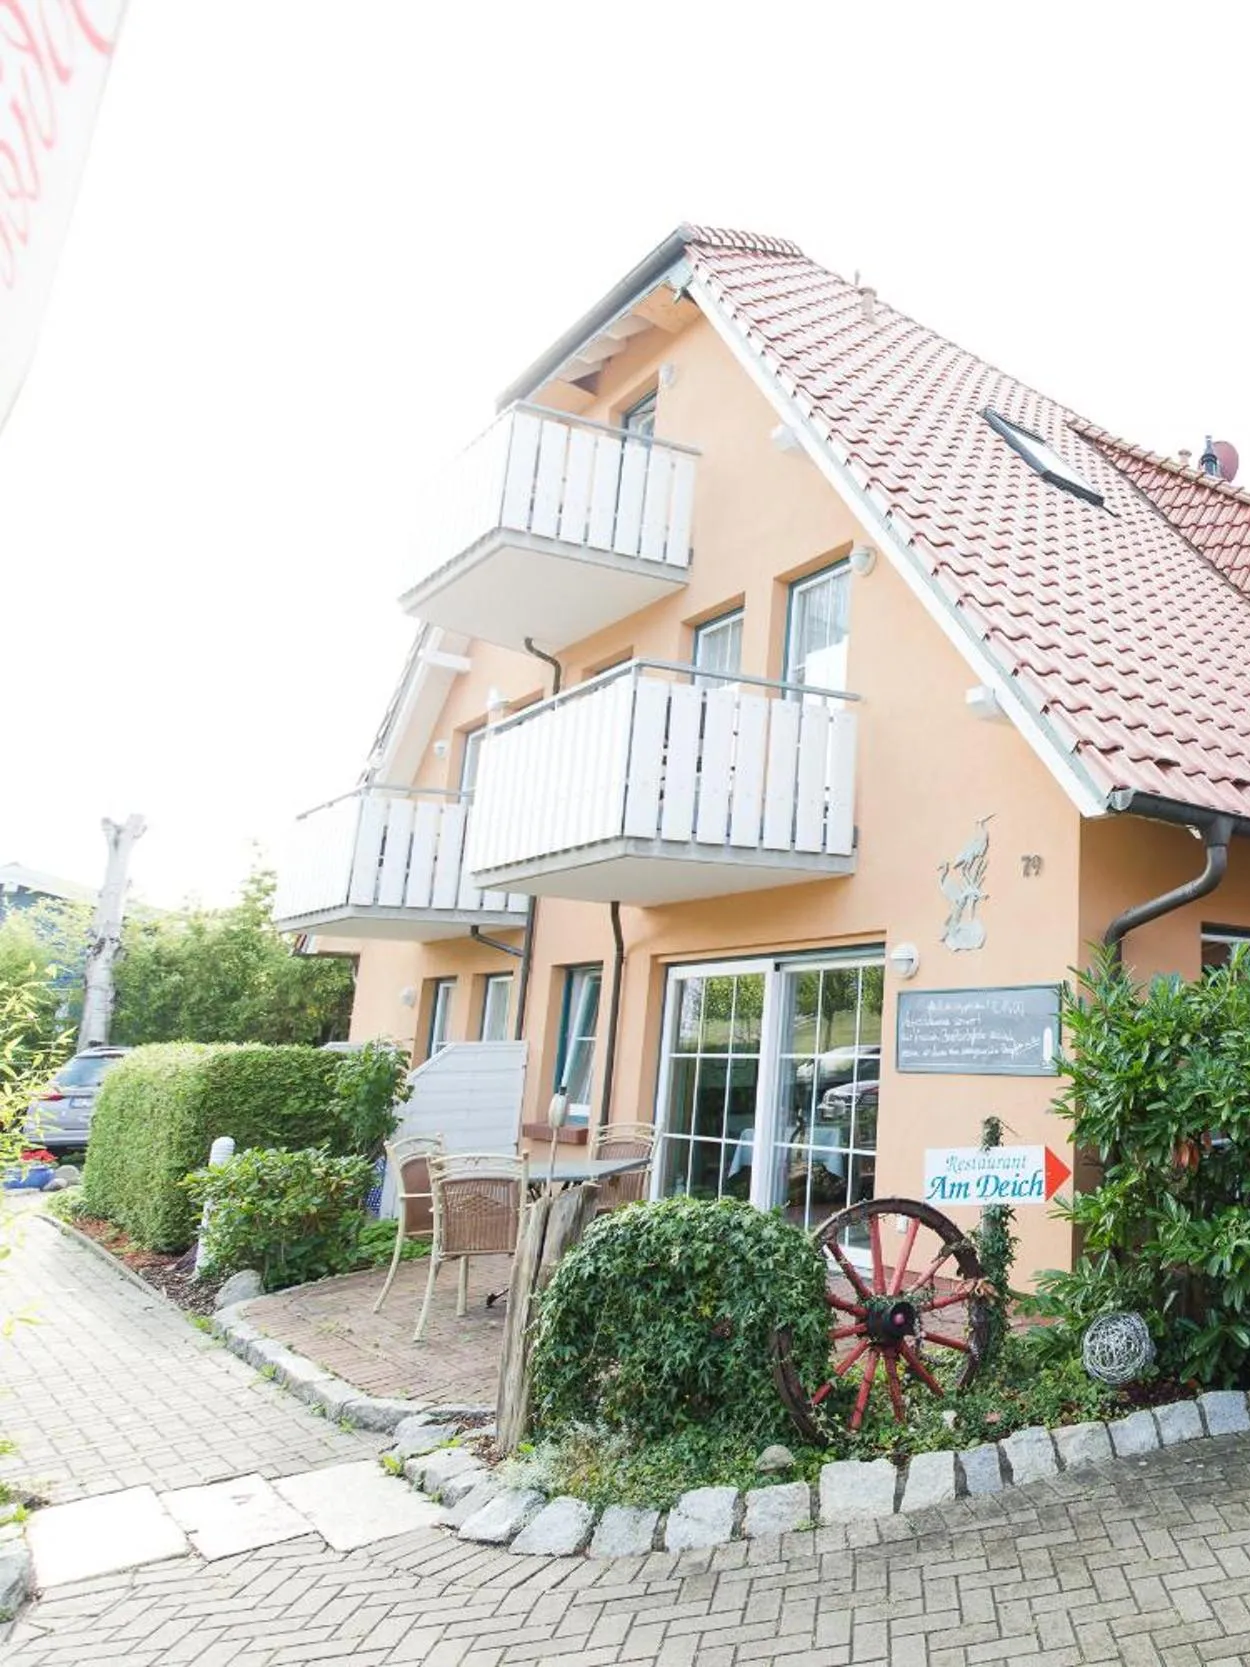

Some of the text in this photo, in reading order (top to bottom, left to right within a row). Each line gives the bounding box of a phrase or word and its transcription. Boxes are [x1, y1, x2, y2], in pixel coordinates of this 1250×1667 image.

[946, 1154, 1027, 1173] Restaurant
[925, 1168, 1044, 1200] Am Deich
